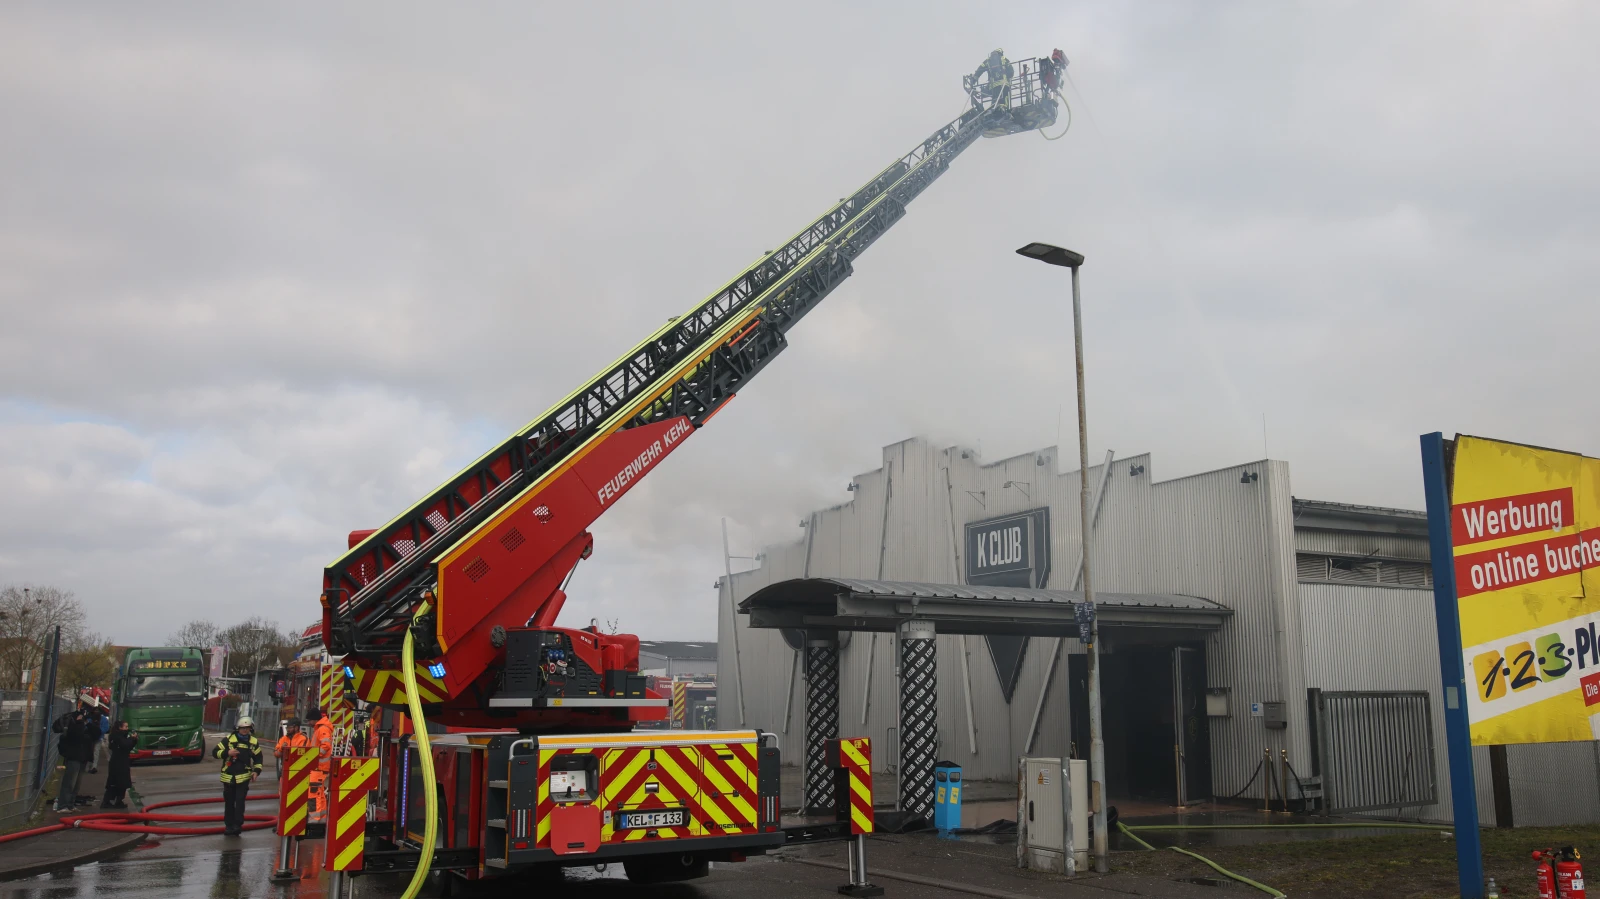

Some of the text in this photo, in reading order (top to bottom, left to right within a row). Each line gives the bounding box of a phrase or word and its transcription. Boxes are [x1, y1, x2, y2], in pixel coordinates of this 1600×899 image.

[597, 418, 691, 505] FEUERWEHR KEHL
[1461, 499, 1562, 539] Werbung
[977, 526, 1022, 568] K CLUB
[1470, 551, 1539, 590] online
[1585, 683, 1599, 698] Die
[627, 812, 682, 827] KEL F 133
